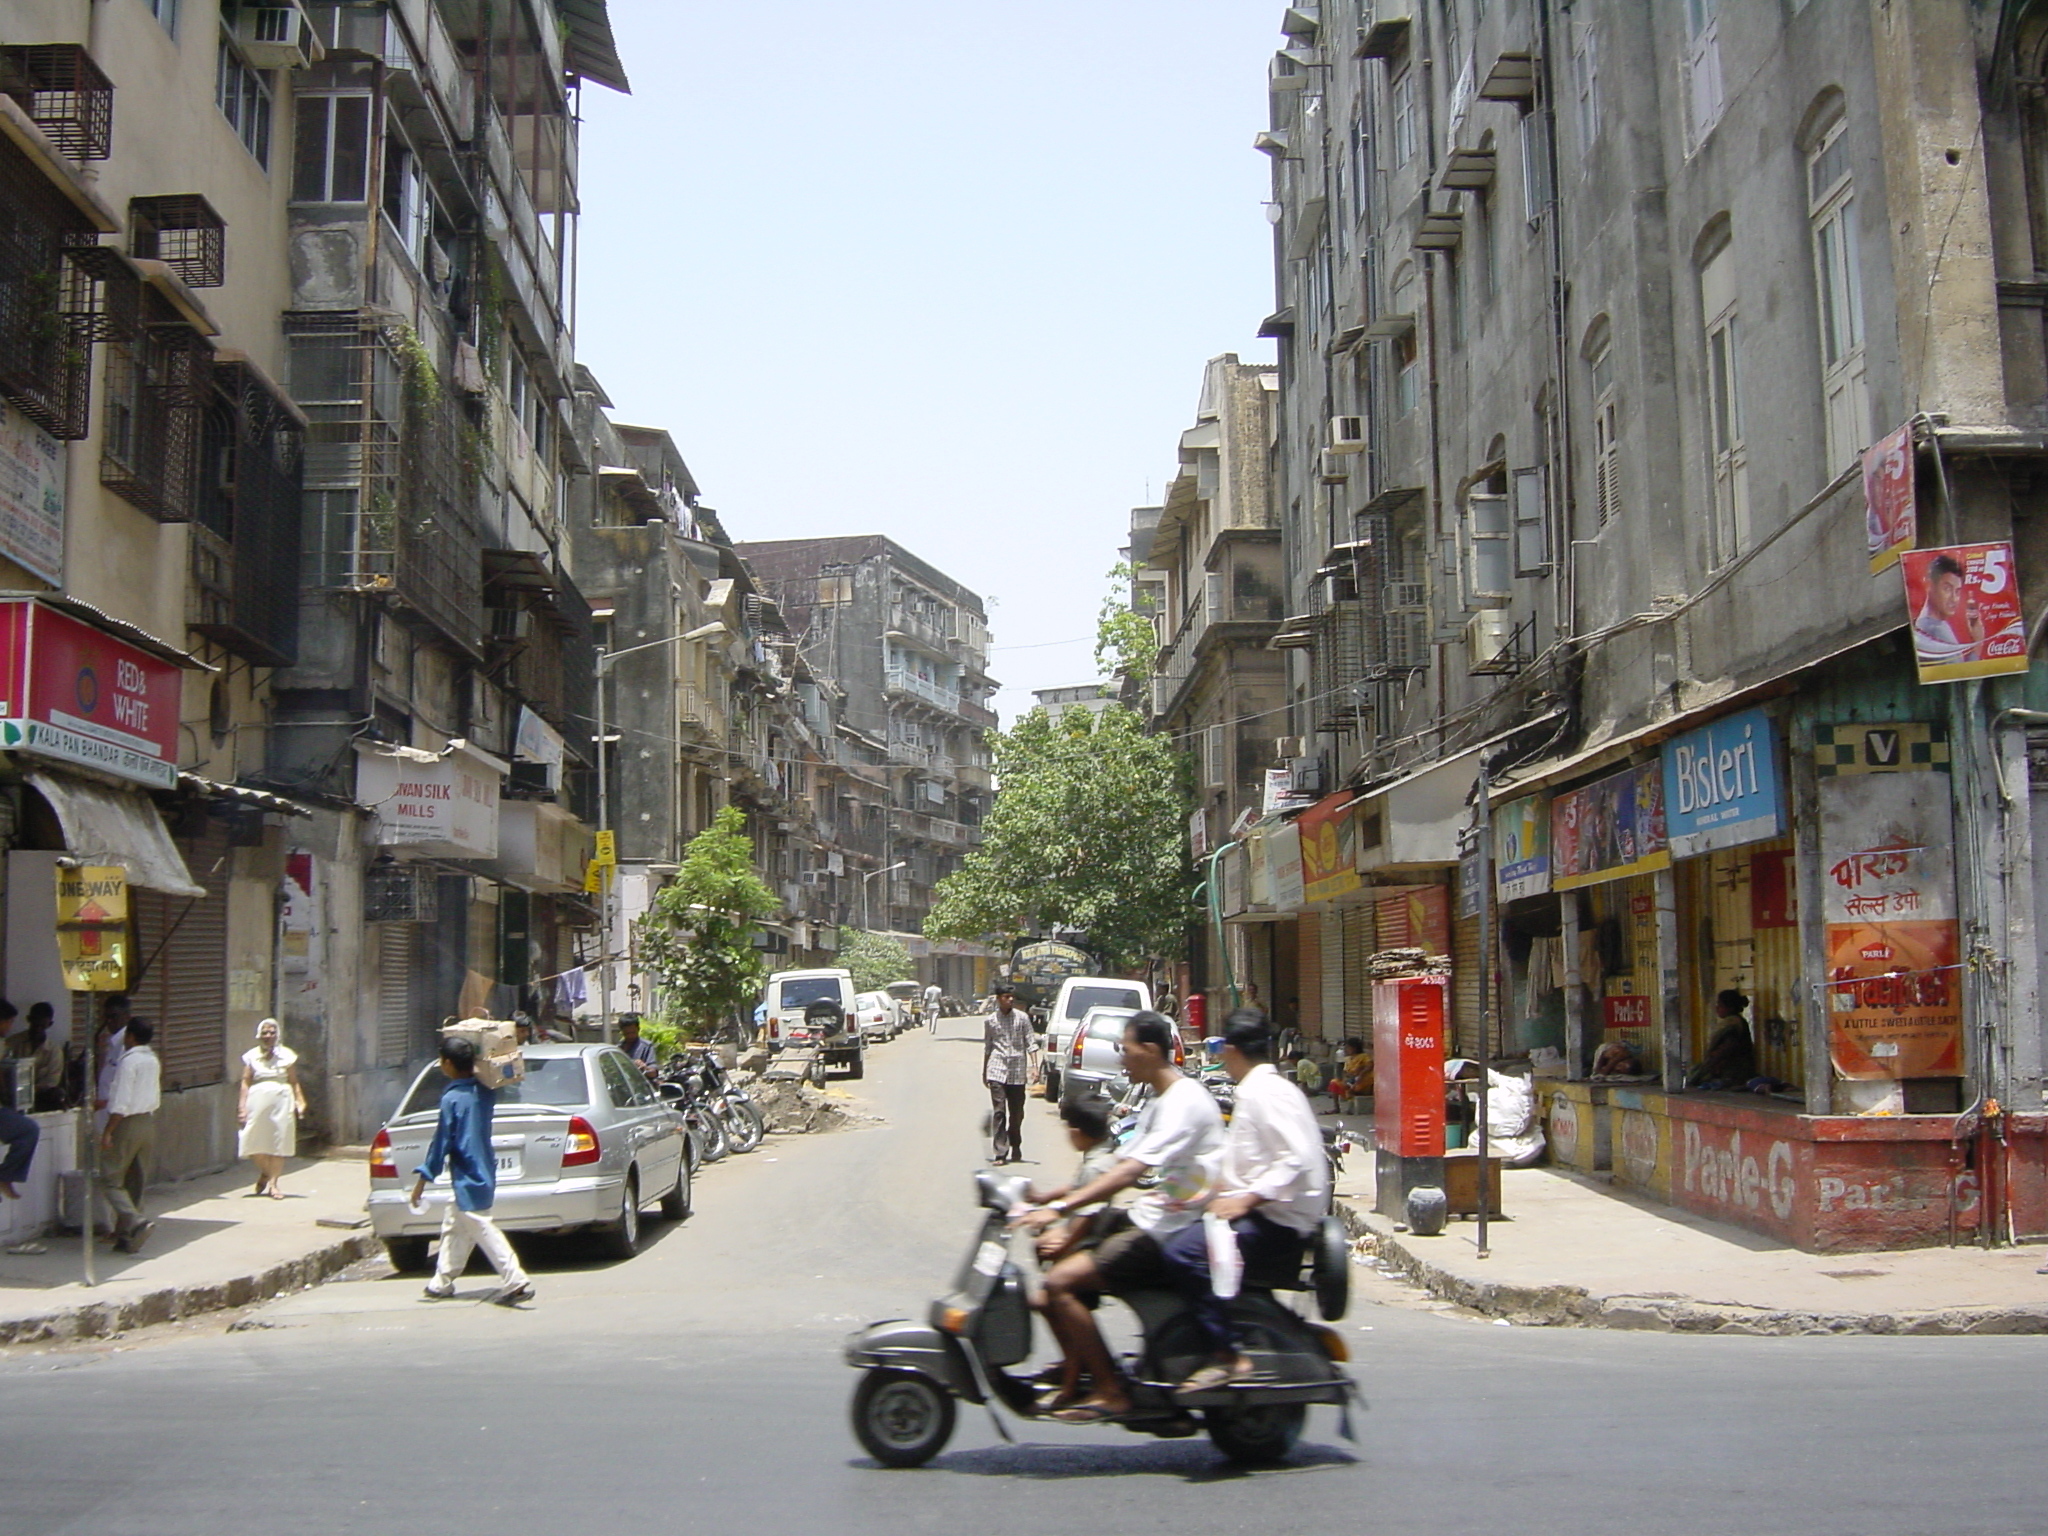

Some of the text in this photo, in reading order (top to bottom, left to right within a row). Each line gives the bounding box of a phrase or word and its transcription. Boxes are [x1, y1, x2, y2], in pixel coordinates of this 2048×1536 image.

[1965, 549, 2006, 594] Rs. 5
[113, 693, 148, 731] WHITE
[38, 725, 60, 748] KALA
[62, 733, 80, 755] PAN
[82, 739, 119, 763] BHANDAR
[1869, 733, 1896, 762] V
[1676, 723, 1759, 815] Bisleri
[425, 784, 451, 800] SILK
[397, 803, 435, 818] MILLS
[1830, 835, 1928, 890] पारले
[59, 880, 122, 897] ONE WAY
[1613, 1000, 1644, 1022] Parle-G
[1851, 1018, 1877, 1029] LITTLE
[1684, 1121, 1796, 1220] Parle-G
